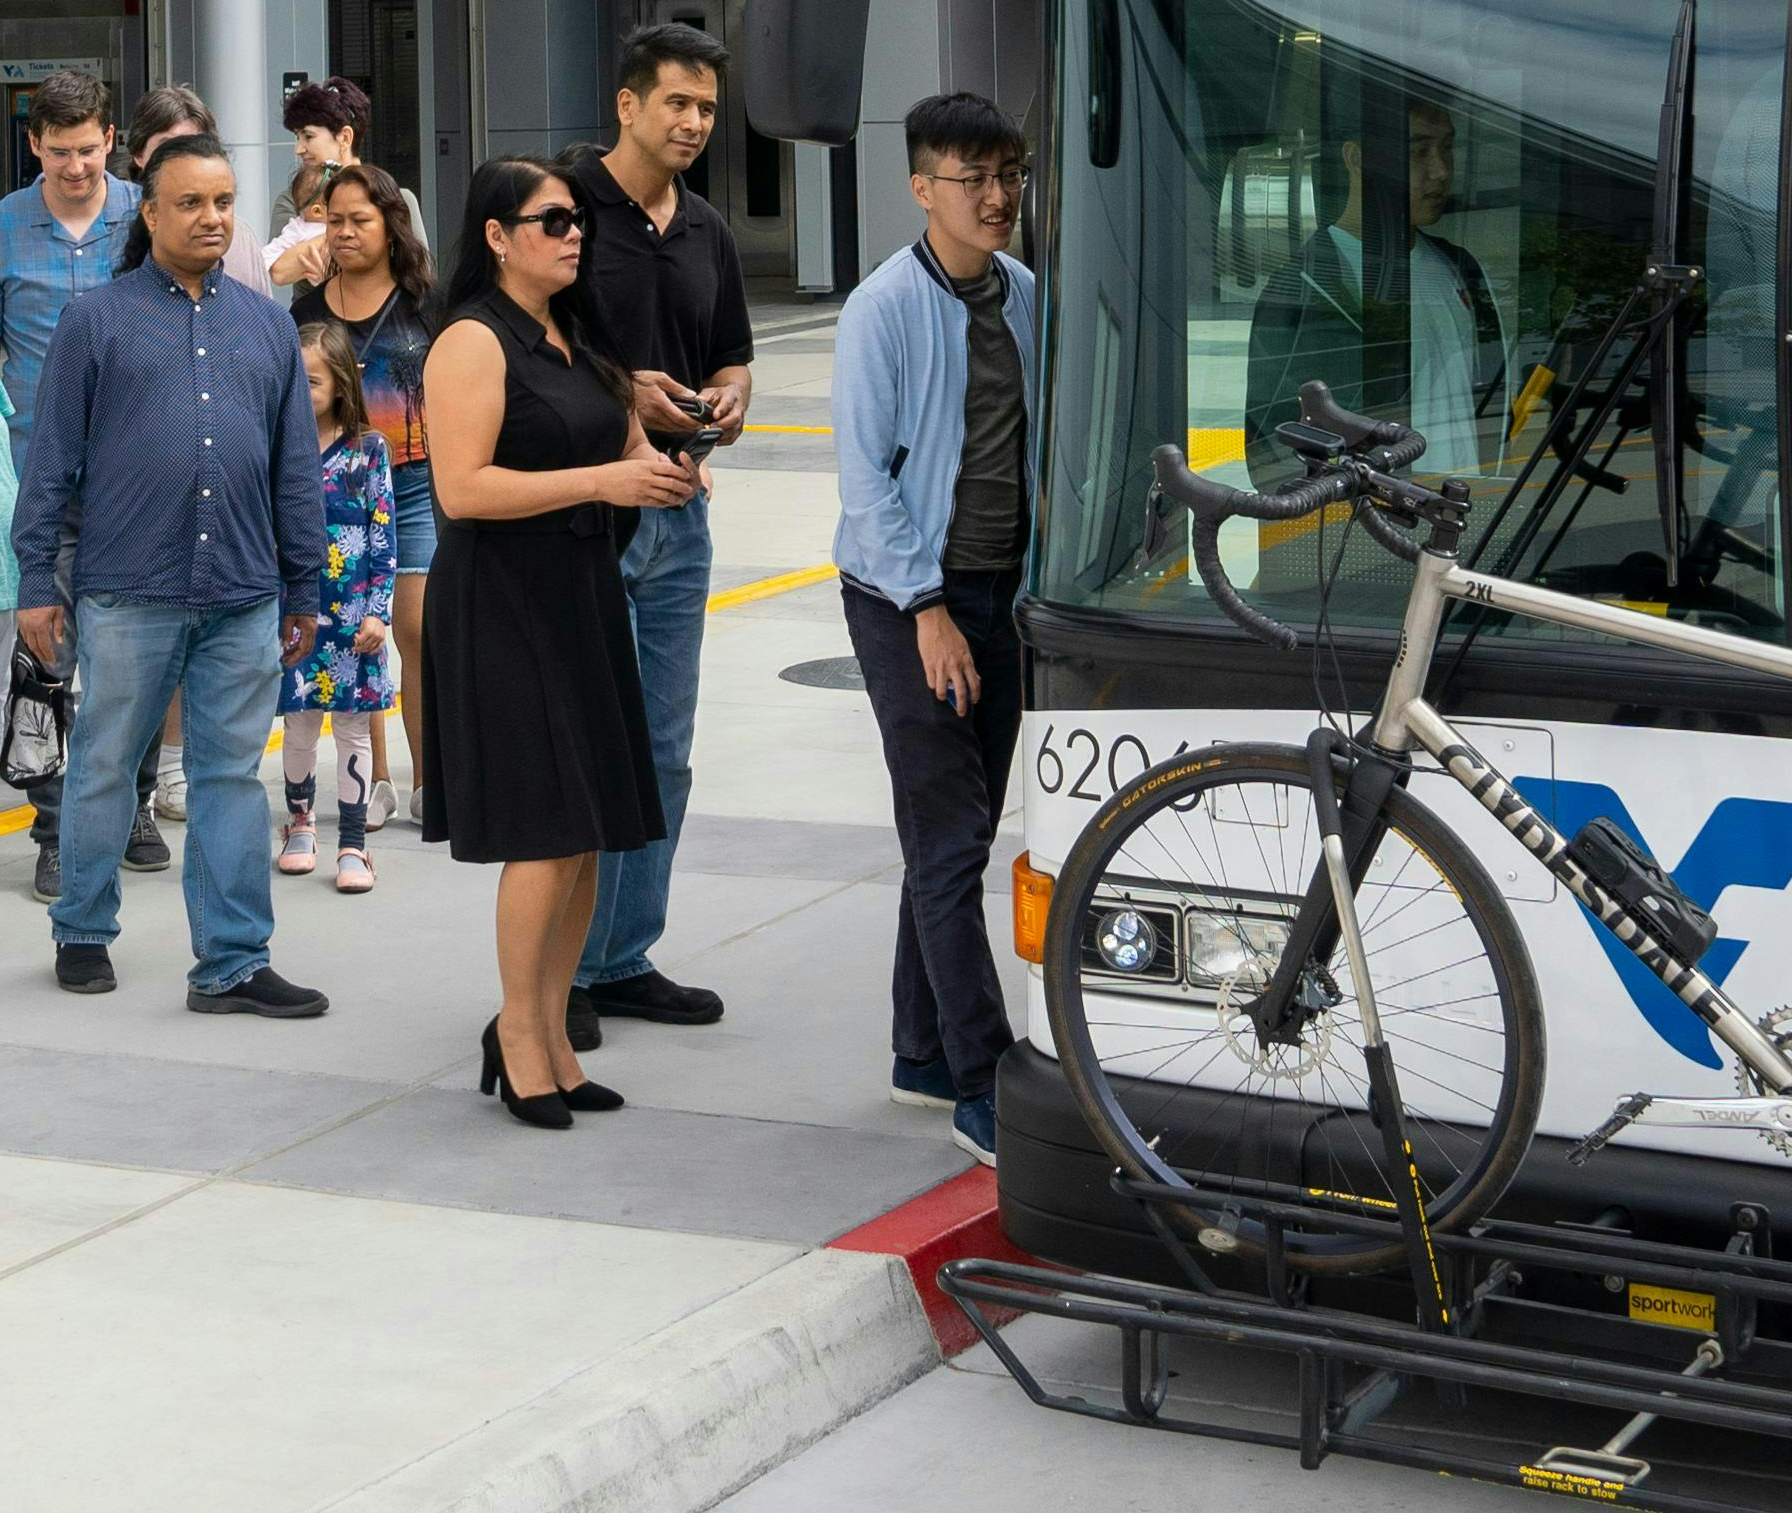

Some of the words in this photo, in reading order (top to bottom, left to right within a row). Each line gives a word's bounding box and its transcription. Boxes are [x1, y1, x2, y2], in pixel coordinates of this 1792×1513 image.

[1464, 580, 1495, 603] 2XL
[1121, 761, 1203, 809] GATORSKIN
[1519, 1466, 1564, 1480] Squeeze
[1565, 1474, 1601, 1487] handle
[1603, 1481, 1625, 1492] and
[1523, 1476, 1549, 1488] raise
[1551, 1480, 1574, 1493] rack
[1577, 1484, 1588, 1495] to
[1591, 1488, 1616, 1500] stow
